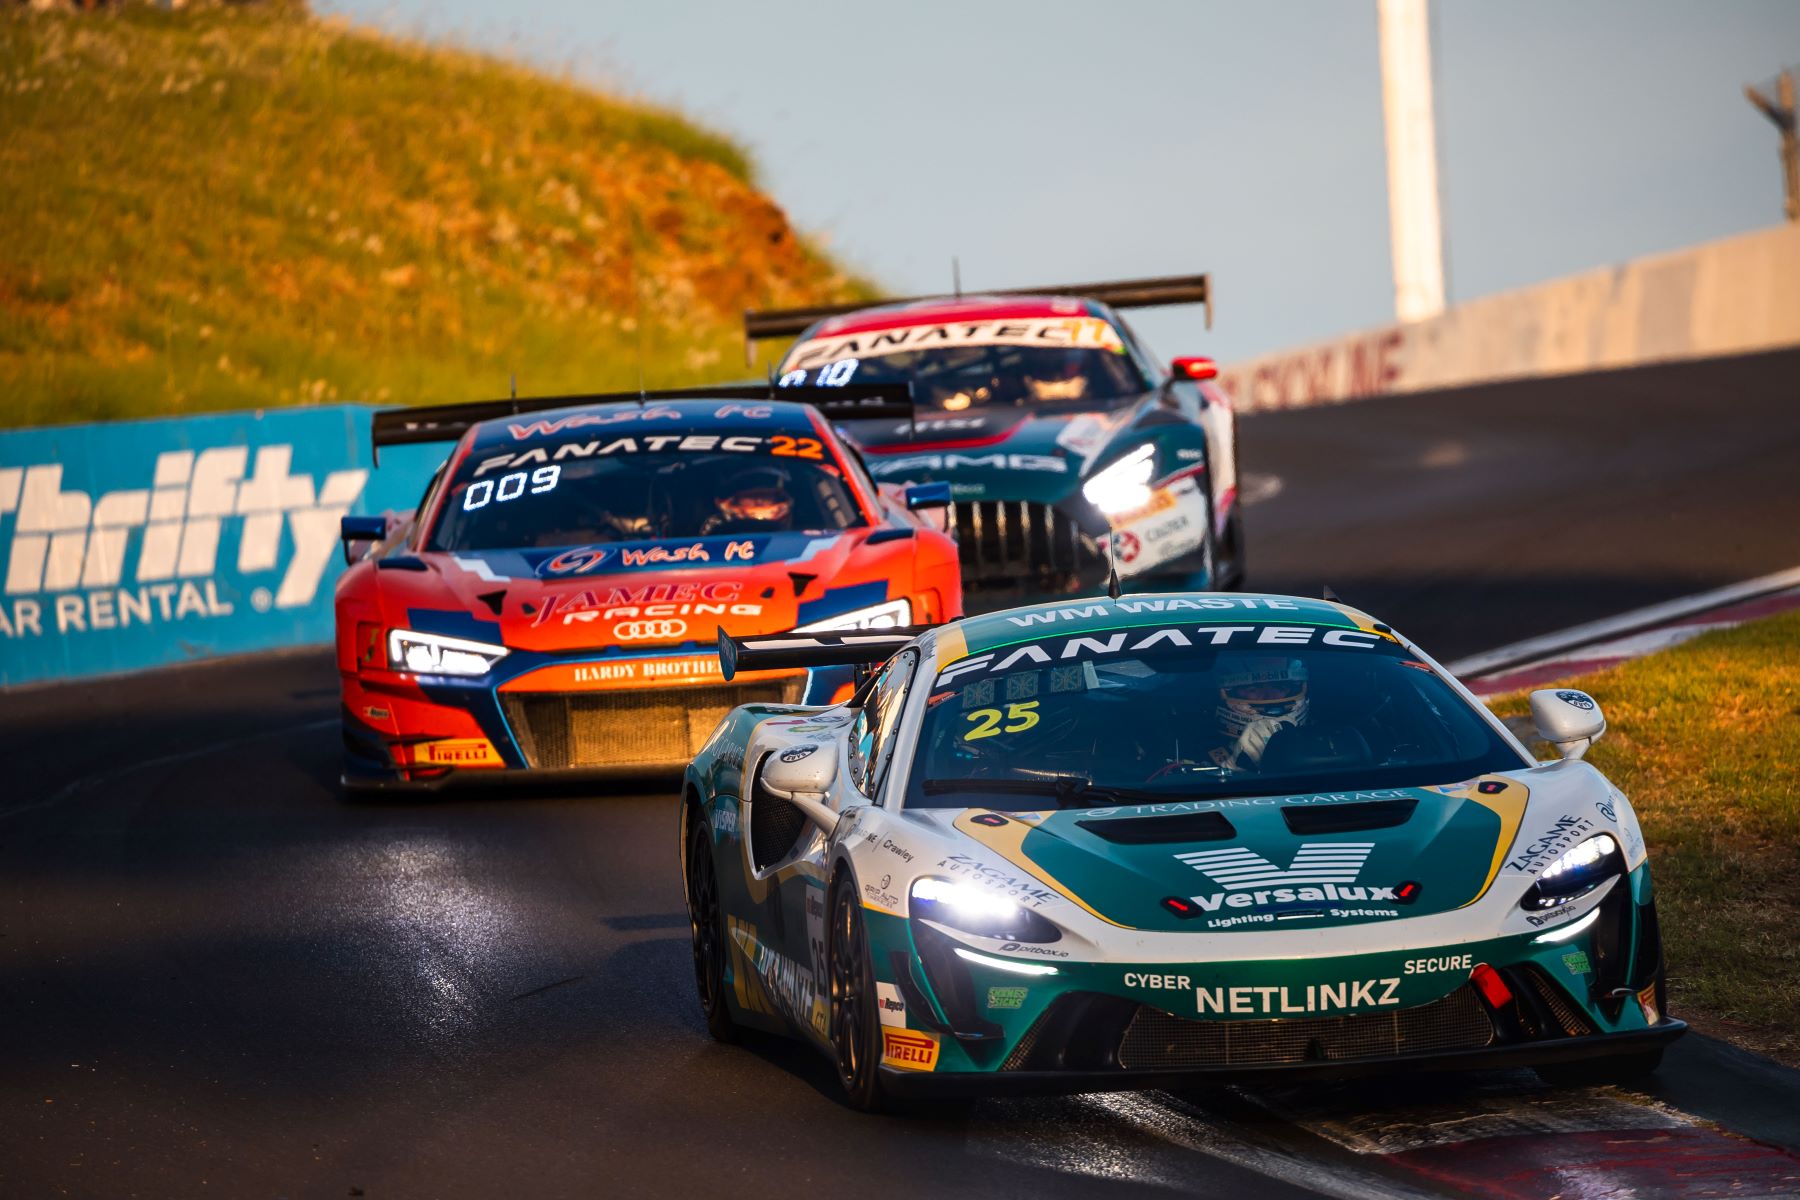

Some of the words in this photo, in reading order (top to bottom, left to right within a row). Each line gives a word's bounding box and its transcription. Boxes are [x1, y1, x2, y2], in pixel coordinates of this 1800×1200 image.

[507, 405, 682, 441] Wash
[472, 435, 764, 477] FANATEC
[770, 435, 824, 460] 22
[462, 464, 562, 512] 009
[621, 543, 710, 567] Wash
[56, 580, 235, 634] RENTAL
[530, 581, 743, 628] JAMEC
[562, 603, 763, 625] RACING
[1006, 604, 1104, 628] WM
[1114, 595, 1299, 615] WASTE
[574, 664, 637, 682] HARDY
[642, 660, 721, 677] BROTHE
[935, 625, 1383, 688] FANATEC
[964, 700, 1040, 741] 25
[428, 743, 487, 761] PIRELLI
[1130, 797, 1275, 814] TRADING
[1284, 789, 1412, 805] GARAGE
[883, 839, 915, 863] Crawley
[1504, 814, 1582, 872] ZAGAME
[1527, 819, 1595, 875] AUTOSPORT
[937, 859, 1042, 908] AUTOSPORT
[946, 853, 1060, 903] ZAGAME
[1190, 883, 1399, 912] Versalux
[1207, 913, 1275, 928] Lighting
[1330, 908, 1399, 917] Systems
[1123, 972, 1192, 990] CYBER
[1403, 954, 1473, 975] SECURE
[1195, 977, 1401, 1014] NETLINKZ
[884, 1032, 935, 1064] PIRELLI
